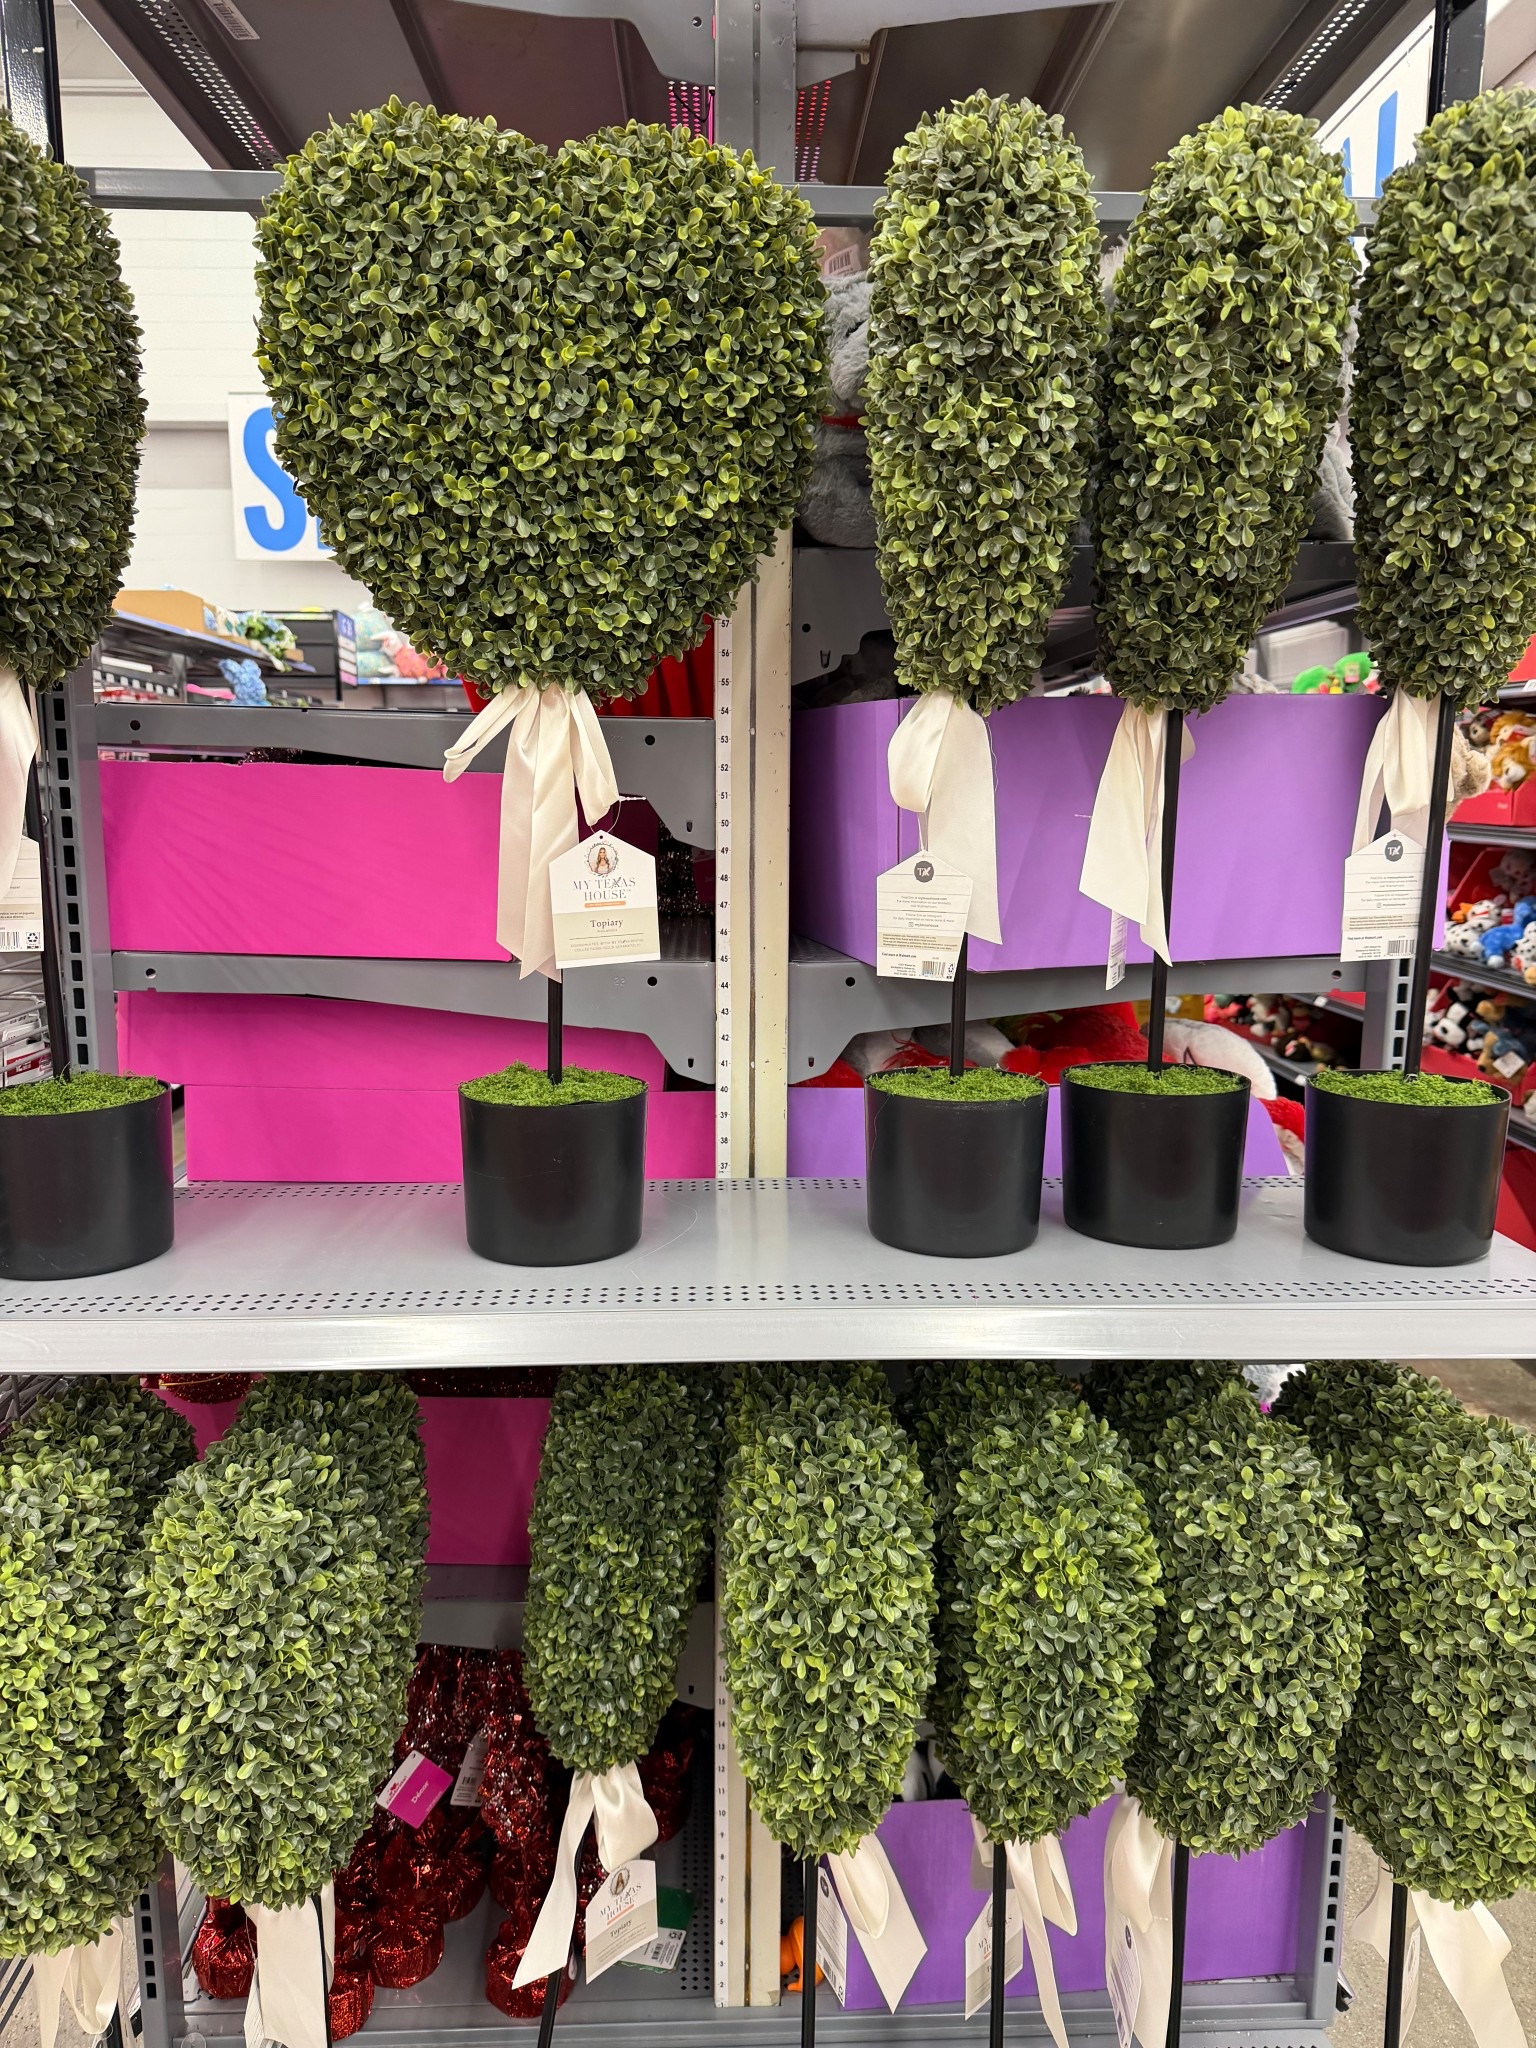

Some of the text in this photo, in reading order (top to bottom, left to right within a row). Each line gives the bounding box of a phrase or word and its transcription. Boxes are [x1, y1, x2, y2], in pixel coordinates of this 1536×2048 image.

[243, 407, 334, 552] S
[573, 877, 636, 890] MY TEXAS
[590, 919, 623, 928] Topiary
[411, 1781, 429, 1804] Décor
[610, 1920, 632, 1938] Topiary
